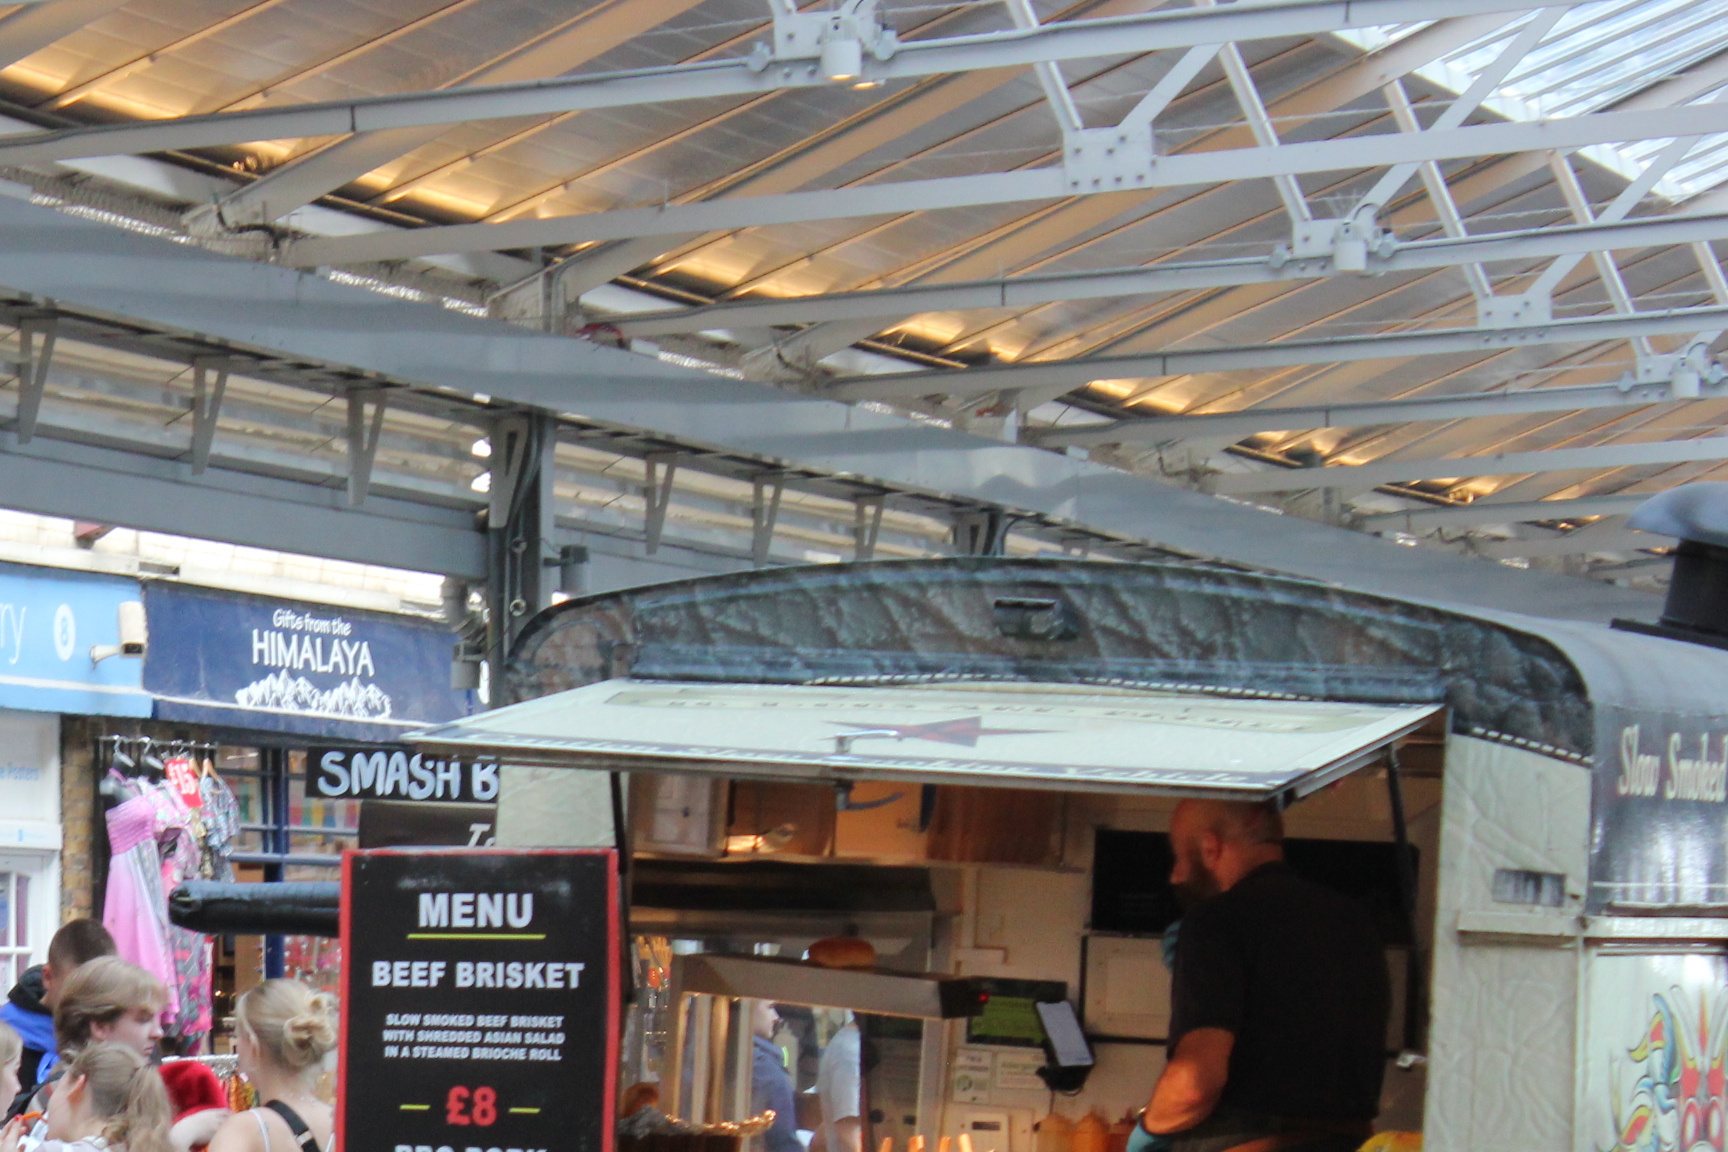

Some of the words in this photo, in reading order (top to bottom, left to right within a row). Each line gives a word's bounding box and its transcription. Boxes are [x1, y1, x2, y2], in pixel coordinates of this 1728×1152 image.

[273, 608, 304, 631] Gifts
[304, 612, 331, 635] from
[331, 616, 352, 637] the
[252, 628, 375, 678] HIMALAYA
[317, 750, 462, 800] SMASH
[1617, 724, 1661, 797] Slow
[418, 893, 534, 929] MENU
[372, 960, 446, 988] BEEF
[456, 961, 585, 991] BRISKET
[382, 1029, 414, 1042] WITH
[416, 1029, 482, 1043] SHREDDED
[483, 1031, 522, 1043] ASIAN
[524, 1031, 566, 1044] SALAD
[386, 1013, 421, 1026] SLOW
[422, 1013, 475, 1027] SMOKED
[476, 1015, 508, 1028] BEEF
[509, 1015, 564, 1028] BRISKET
[384, 1045, 399, 1058] IN
[400, 1046, 411, 1058] A
[412, 1046, 470, 1059] STEAMED
[471, 1047, 527, 1060] BRIOCHE
[528, 1048, 563, 1061] ROLL
[446, 1086, 497, 1127] £8
